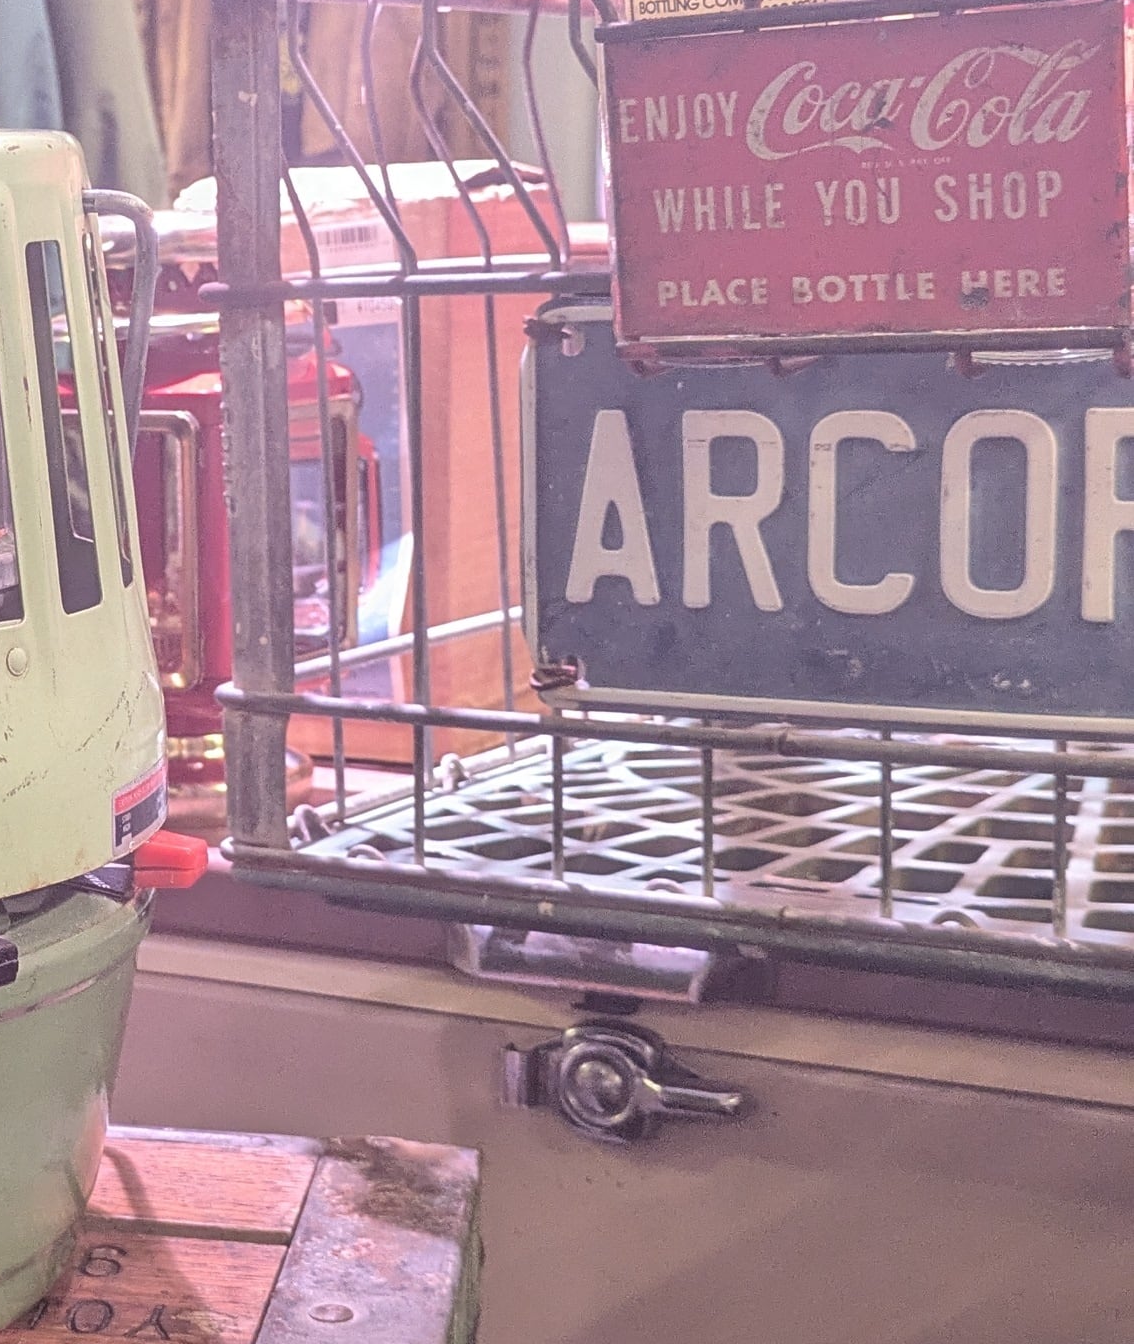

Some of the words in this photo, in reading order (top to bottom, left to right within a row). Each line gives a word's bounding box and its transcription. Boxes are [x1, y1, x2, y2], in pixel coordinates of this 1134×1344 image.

[618, 90, 739, 144] ENJOY
[746, 39, 1107, 161] Coca-Cola
[653, 182, 786, 234] WHILE
[814, 175, 902, 228] YOU
[933, 169, 1064, 223] SHOP
[657, 276, 769, 308] PLACE
[792, 271, 936, 305] BOTTLE
[961, 267, 1067, 301] HERE
